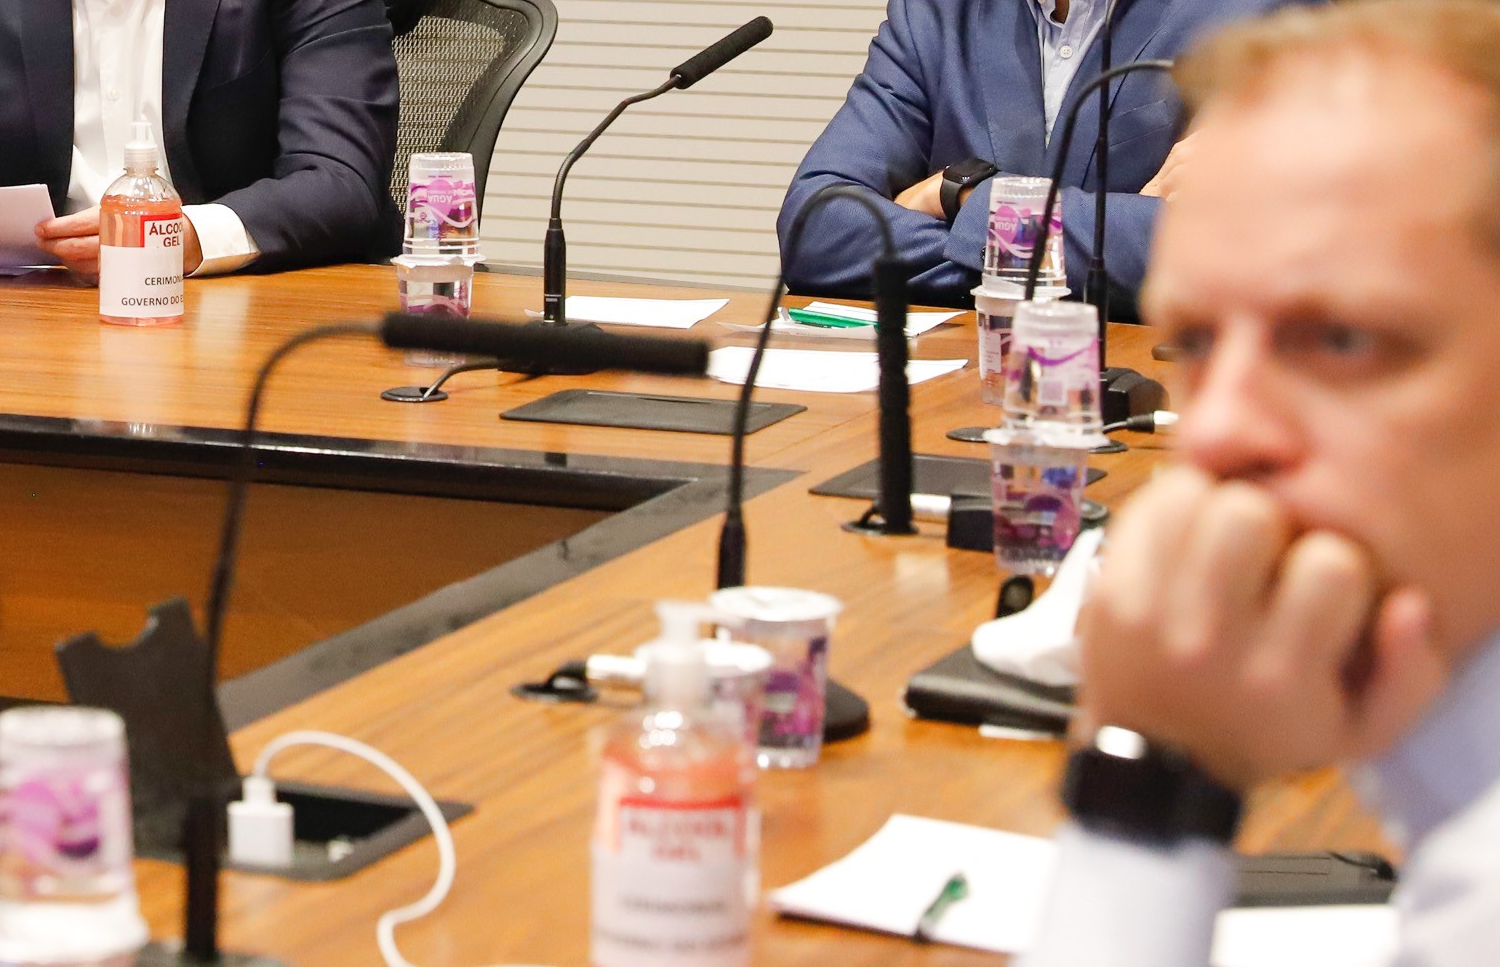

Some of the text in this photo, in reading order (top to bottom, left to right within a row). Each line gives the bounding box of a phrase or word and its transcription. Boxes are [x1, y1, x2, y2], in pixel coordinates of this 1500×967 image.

[163, 236, 180, 247] GEL
[121, 297, 169, 306] GOVERNO
[170, 295, 180, 304] DO
